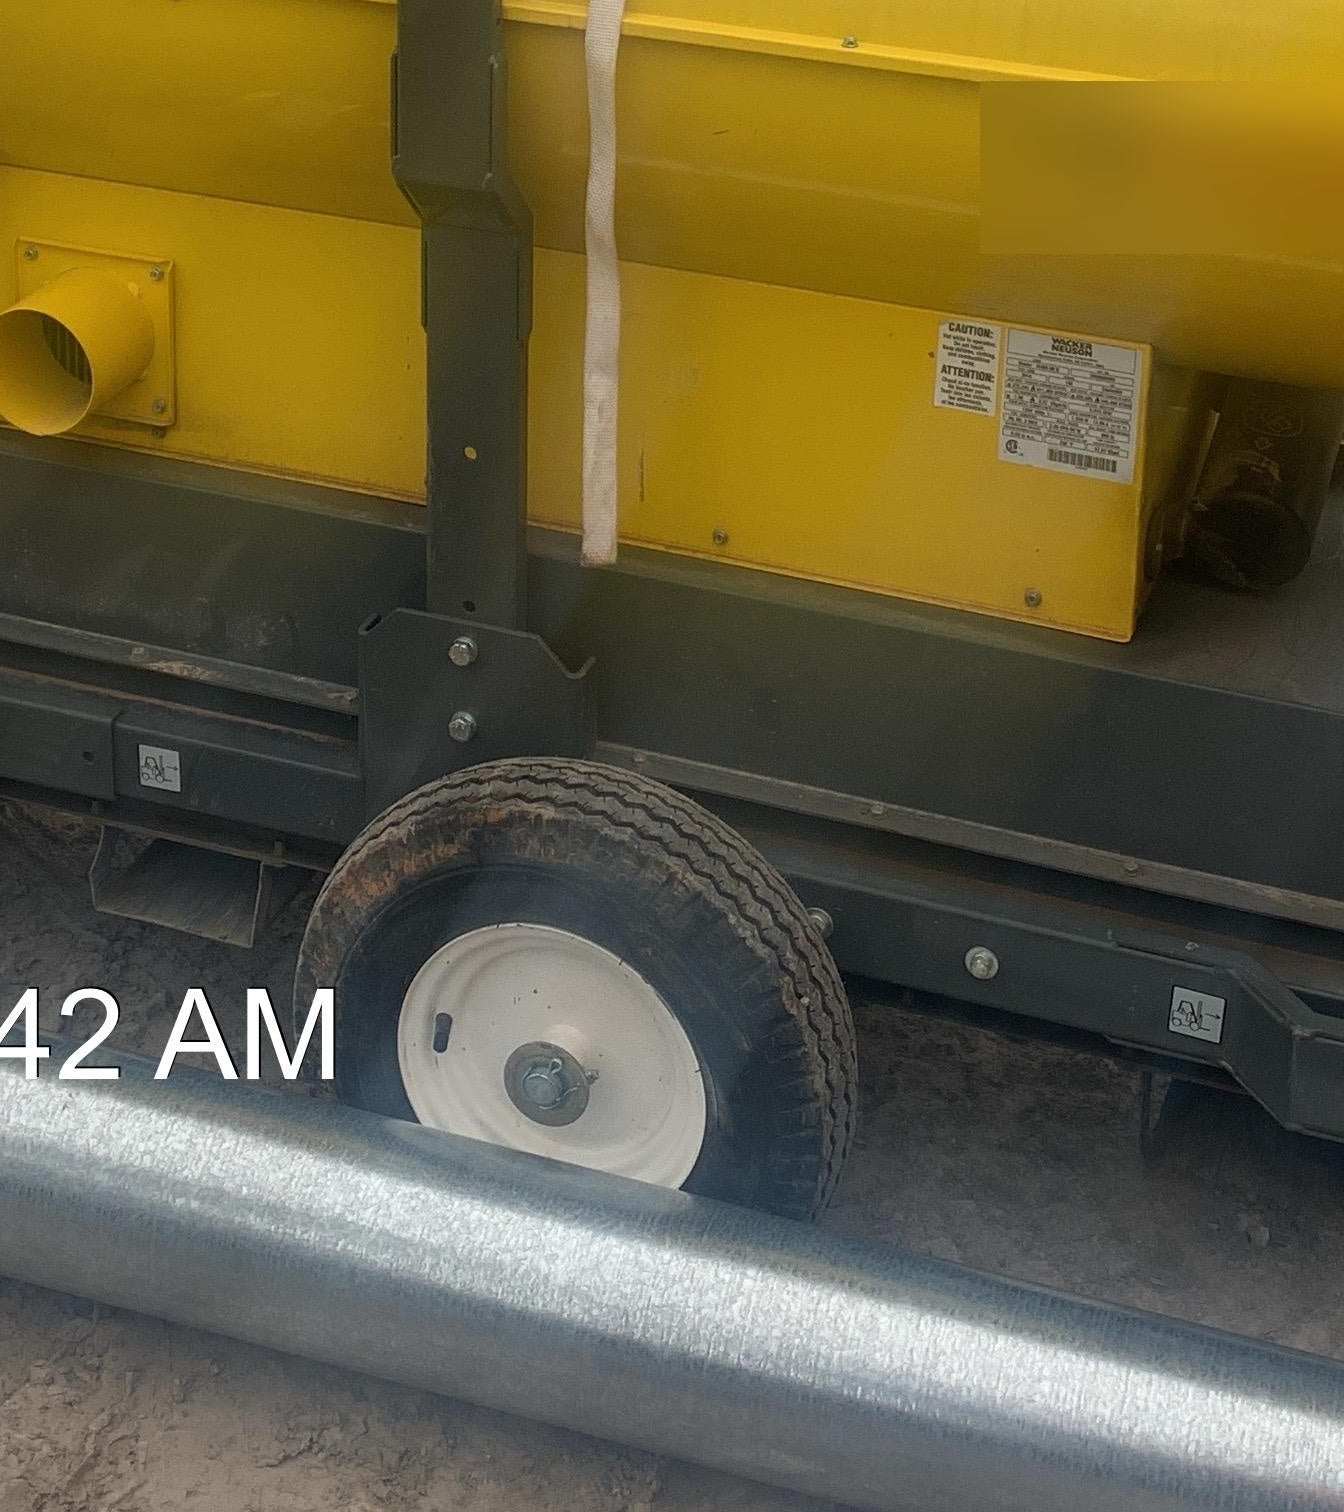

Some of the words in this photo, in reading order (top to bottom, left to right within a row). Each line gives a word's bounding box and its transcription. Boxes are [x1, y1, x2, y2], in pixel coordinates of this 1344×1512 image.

[948, 322, 994, 339] CAUTION:
[1051, 336, 1093, 350] WACKER
[1051, 344, 1093, 357] NEUSON
[940, 364, 995, 383] ATTENTION:
